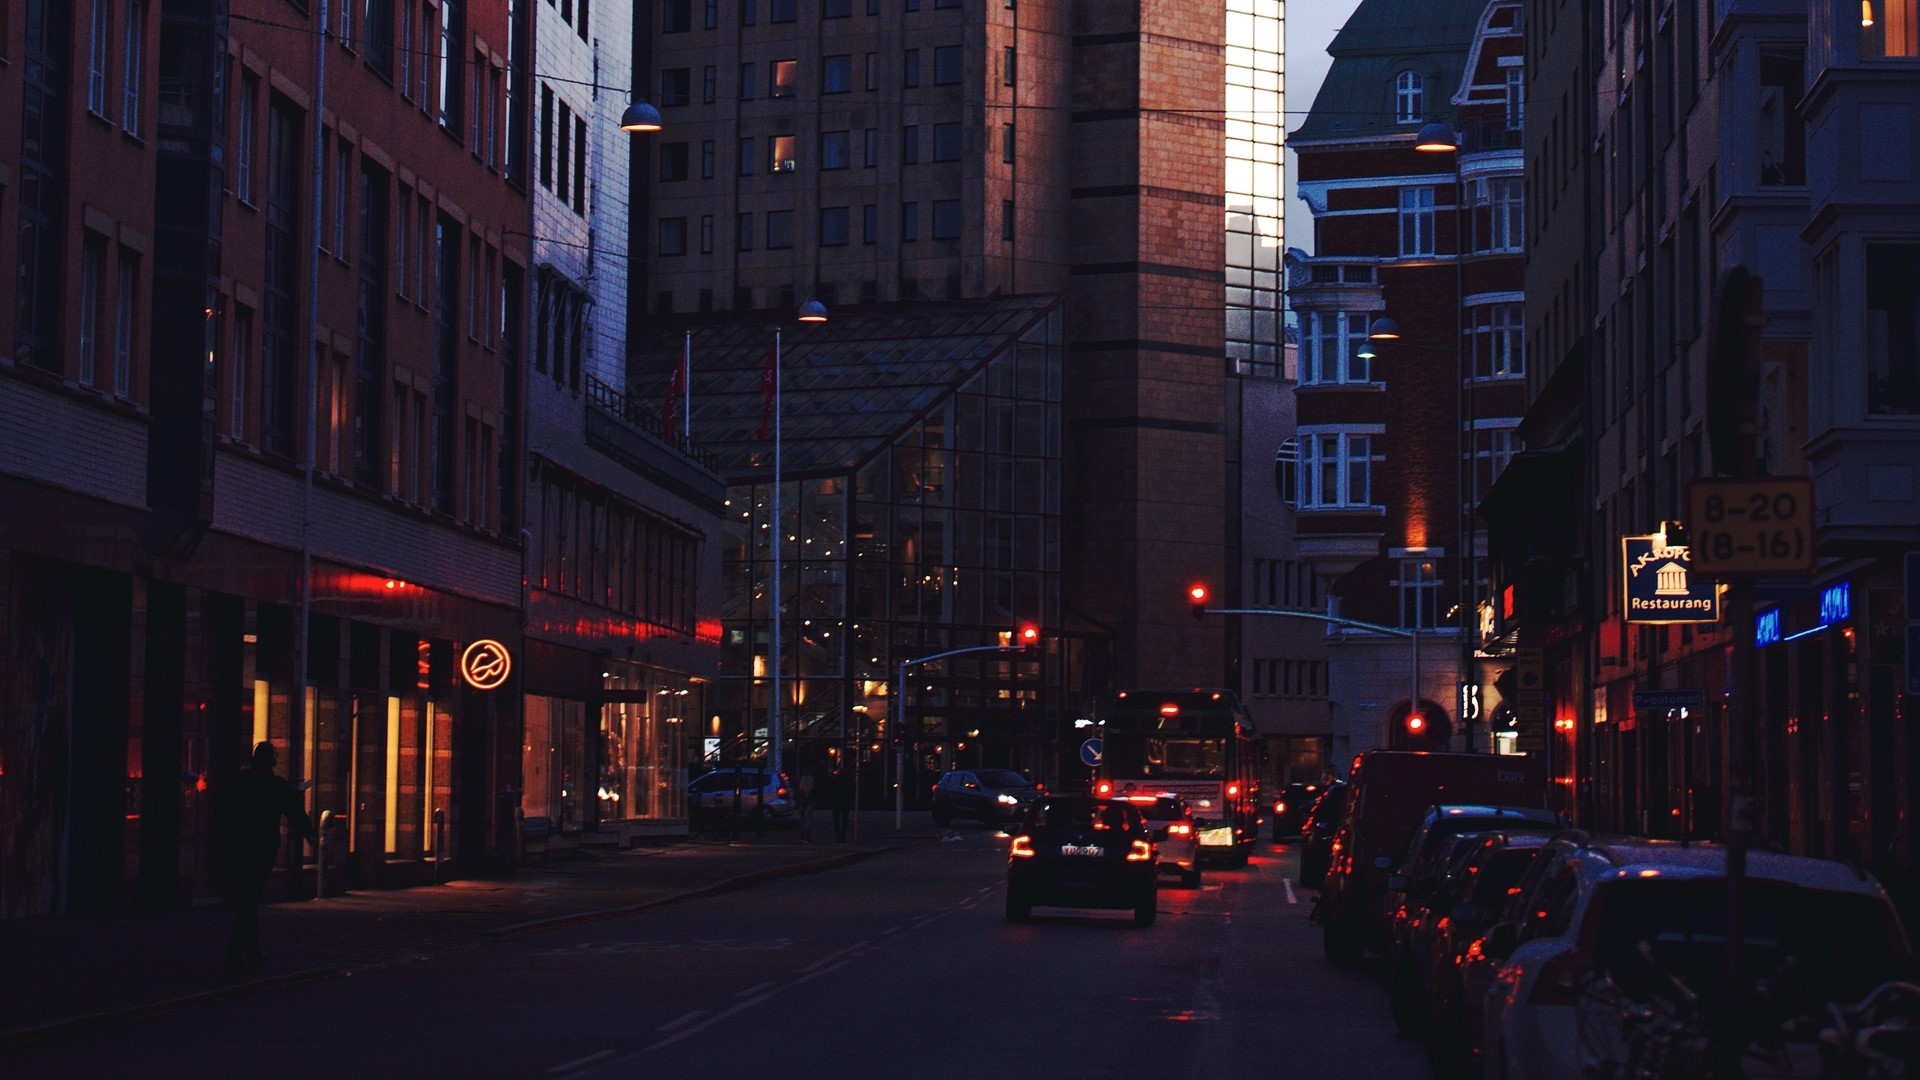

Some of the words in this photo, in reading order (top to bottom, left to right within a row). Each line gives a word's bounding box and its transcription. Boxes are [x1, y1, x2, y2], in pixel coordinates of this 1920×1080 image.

[1704, 492, 1796, 523] 8-20
[1699, 527, 1803, 564] (8-16)
[1631, 597, 1711, 611] Restaurang
[1157, 716, 1167, 730] 7
